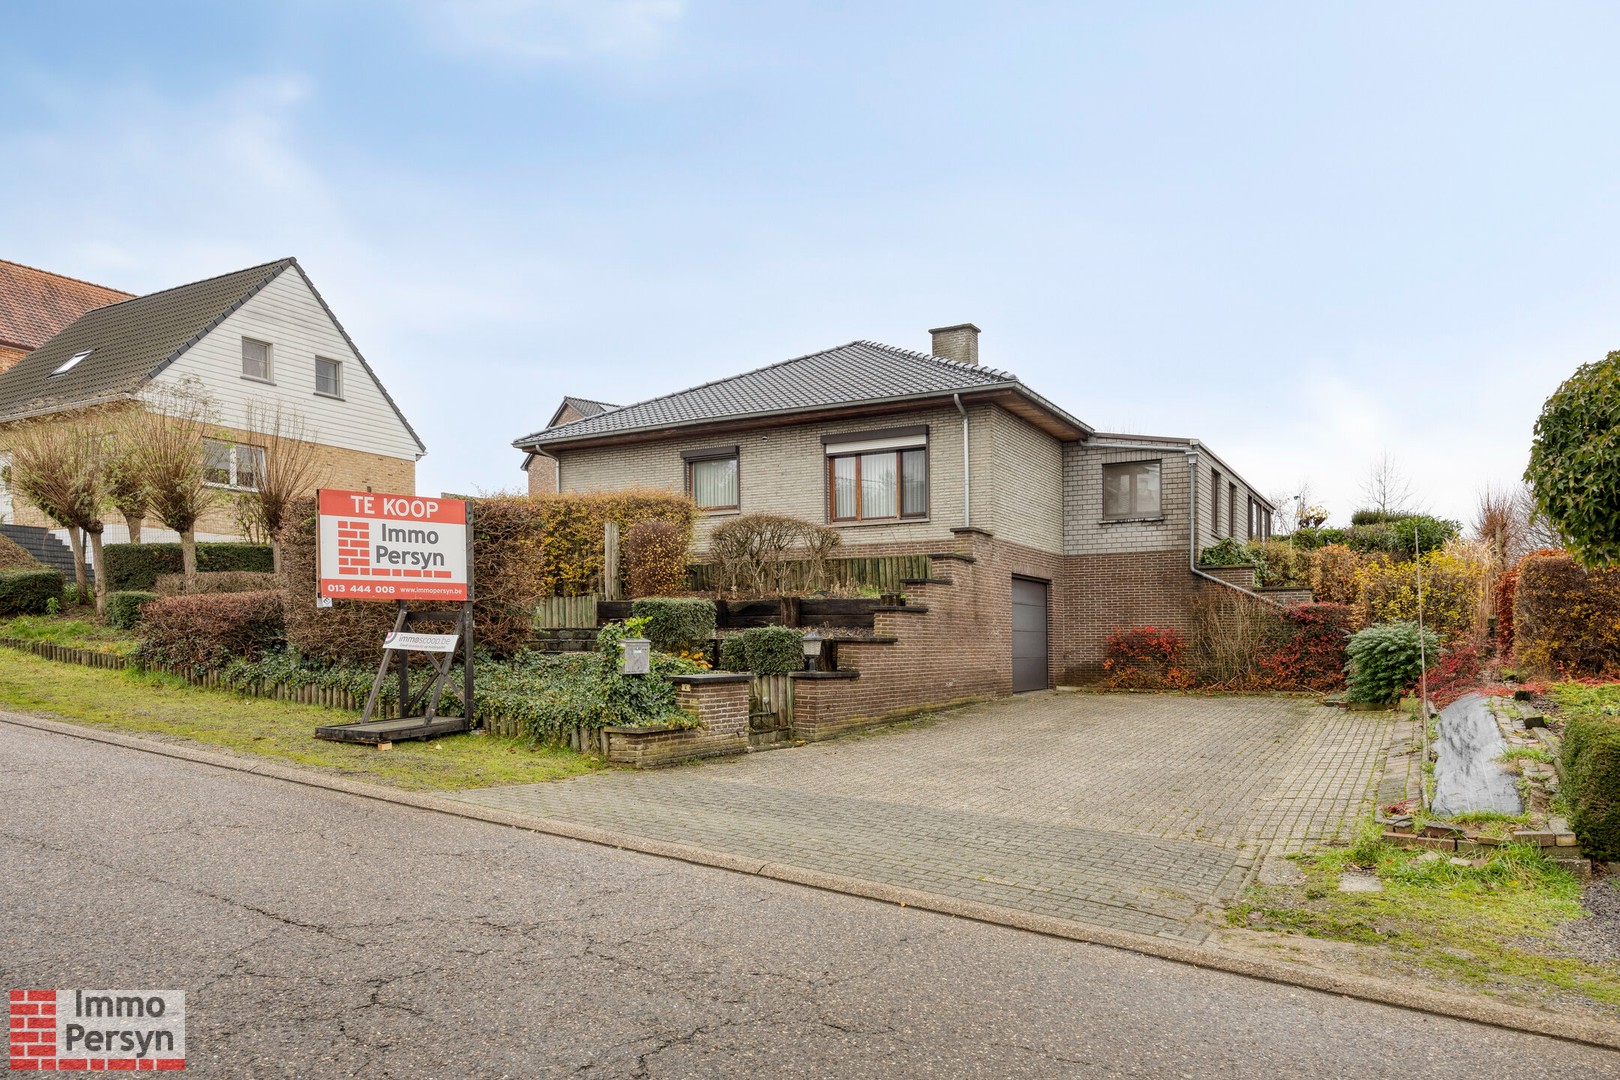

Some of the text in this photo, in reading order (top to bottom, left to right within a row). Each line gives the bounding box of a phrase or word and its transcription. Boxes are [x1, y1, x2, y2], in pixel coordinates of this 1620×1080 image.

[350, 495, 439, 518] TE KOOP
[381, 523, 439, 544] Immo
[376, 545, 444, 569] Persyn
[327, 584, 462, 595] 013 444 008 www.immopersyn.be
[398, 635, 450, 645] immoscoop.be
